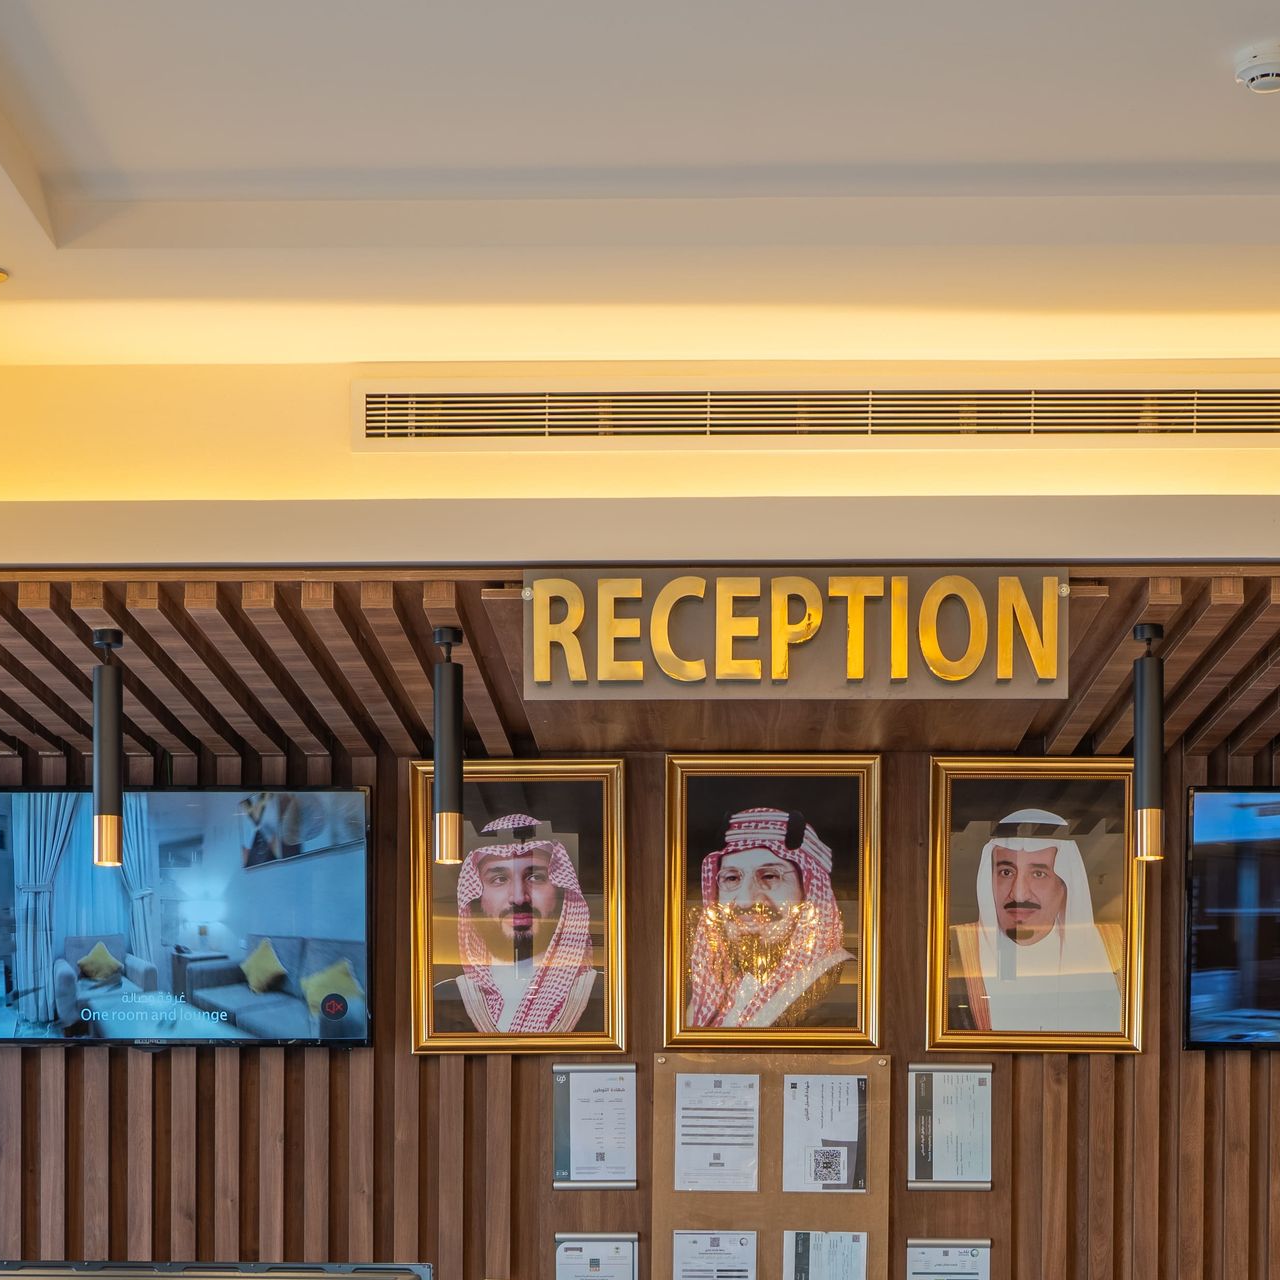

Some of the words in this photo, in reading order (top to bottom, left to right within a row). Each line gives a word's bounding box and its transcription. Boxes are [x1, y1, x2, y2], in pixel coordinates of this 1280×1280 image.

[532, 575, 1059, 683] RECEPTION
[80, 1008, 109, 1021] One
[112, 1010, 148, 1021] room
[151, 1008, 177, 1021] and
[180, 1008, 228, 1024] lounge
